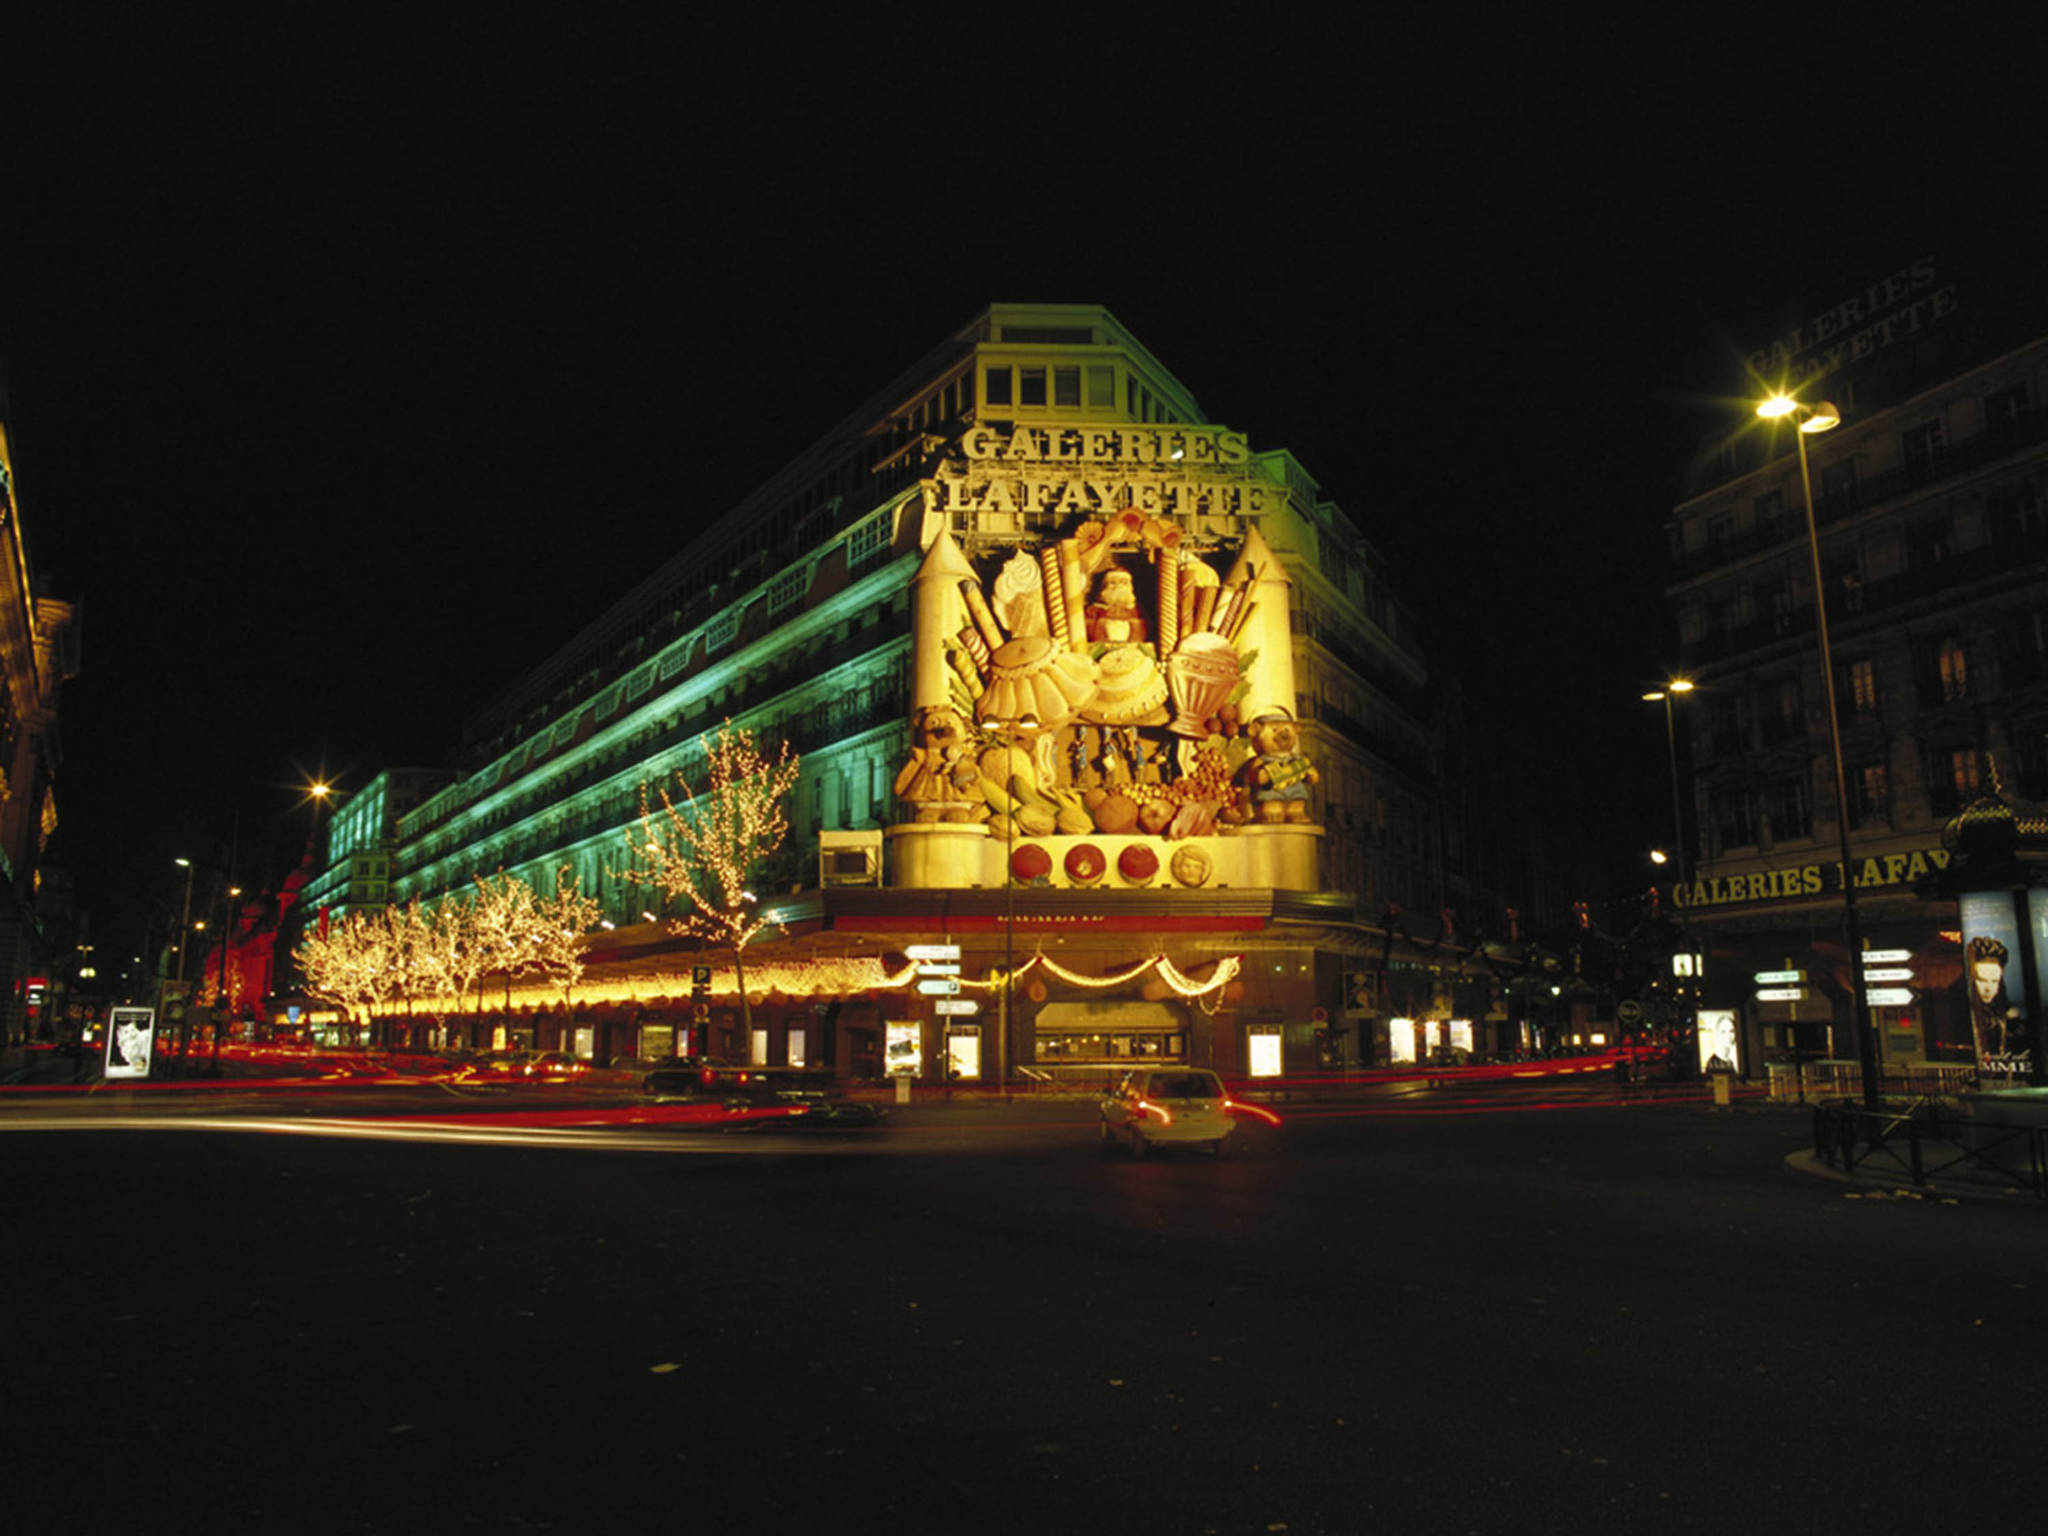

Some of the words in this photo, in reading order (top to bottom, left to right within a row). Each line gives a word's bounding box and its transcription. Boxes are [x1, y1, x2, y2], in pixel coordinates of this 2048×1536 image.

[1748, 255, 1936, 373] GALERIES
[962, 428, 1249, 464] GALERIES
[943, 479, 1270, 514] LAFAYETTE
[1672, 864, 1822, 909] GALERIES
